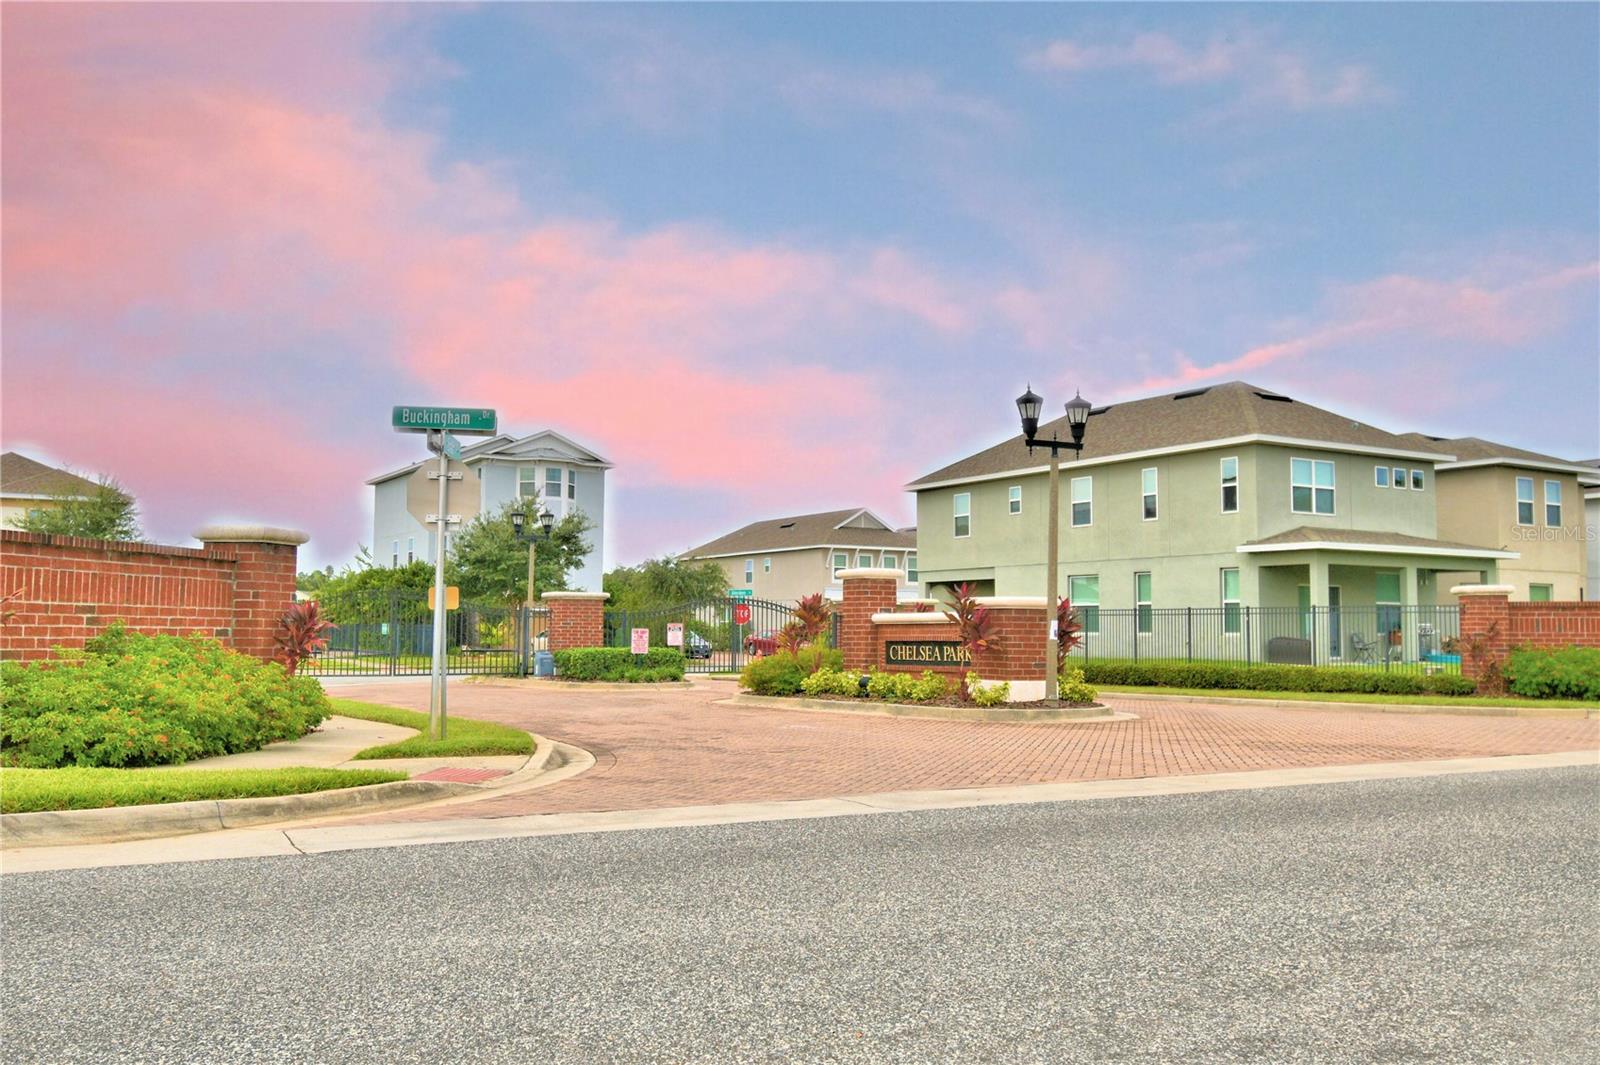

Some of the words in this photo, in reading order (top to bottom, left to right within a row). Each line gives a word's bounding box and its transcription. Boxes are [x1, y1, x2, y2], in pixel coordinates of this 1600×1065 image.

[402, 408, 471, 426] Buckingham
[889, 645, 941, 661] CHELSEA
[943, 645, 972, 662] PARK
